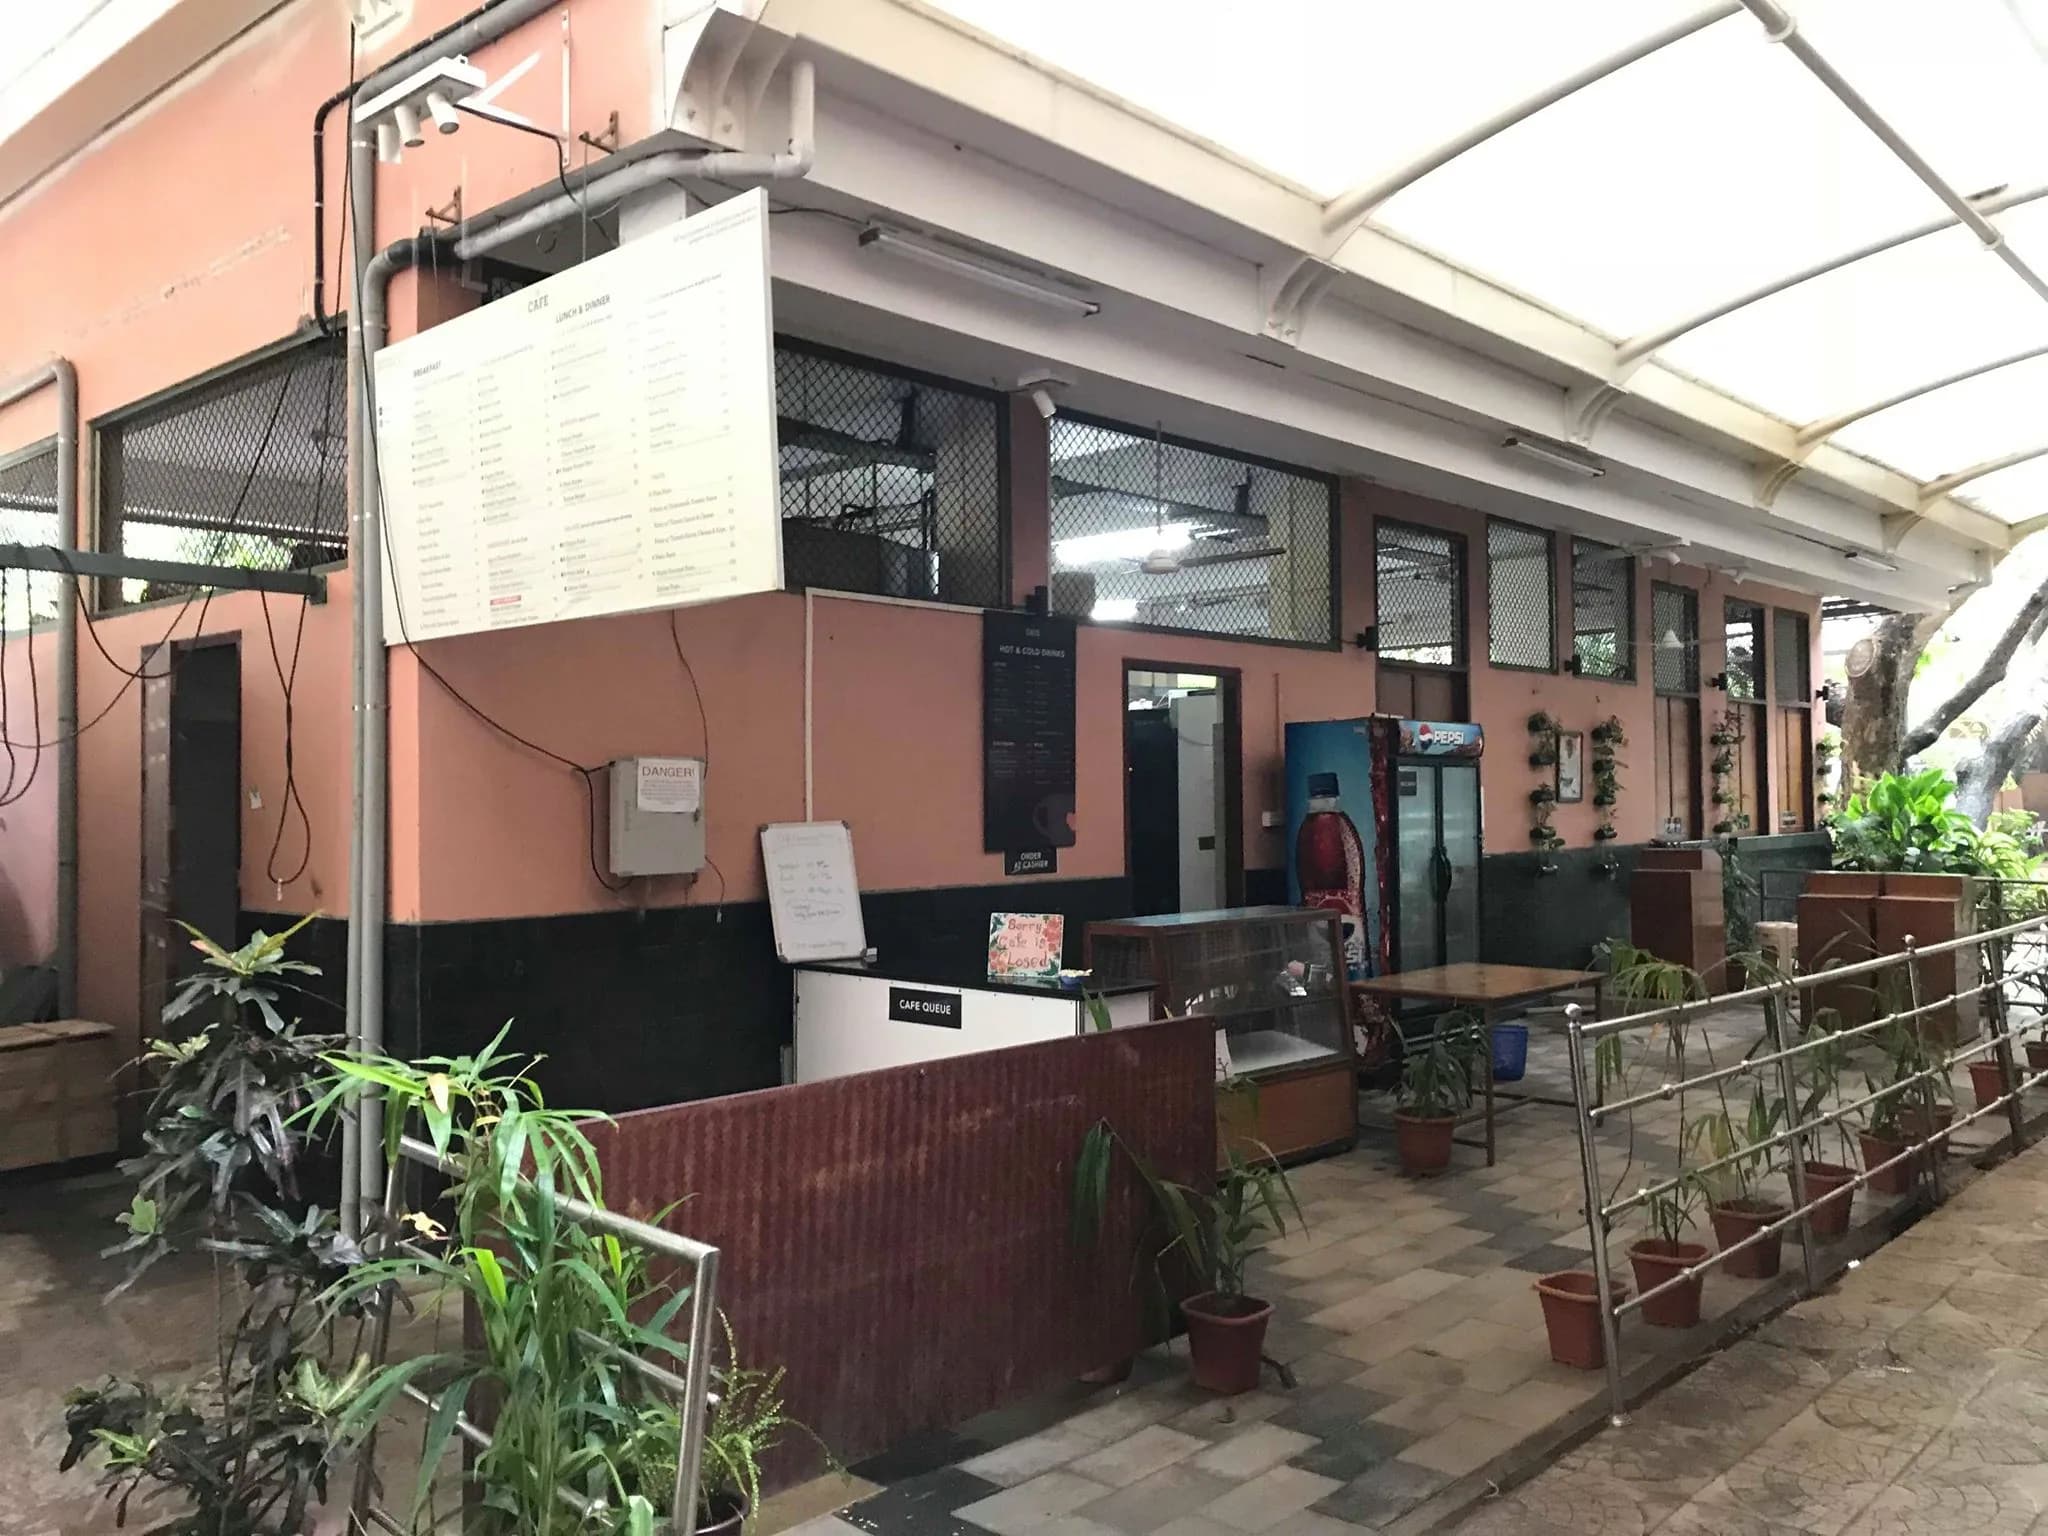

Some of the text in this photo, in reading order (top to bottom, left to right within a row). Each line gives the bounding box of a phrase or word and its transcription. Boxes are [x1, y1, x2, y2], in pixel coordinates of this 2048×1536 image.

[527, 294, 549, 313] CAFE
[555, 308, 577, 324] LUNCH
[585, 294, 611, 312] DINNER
[999, 644, 1065, 658] HOT & COLD DRINKS
[1433, 730, 1464, 745] PEPSI
[642, 766, 696, 778] DANGER!
[1020, 852, 1042, 861] ORDER
[1022, 860, 1049, 869] CASHIER
[899, 999, 951, 1016] CAFE QUEUE
